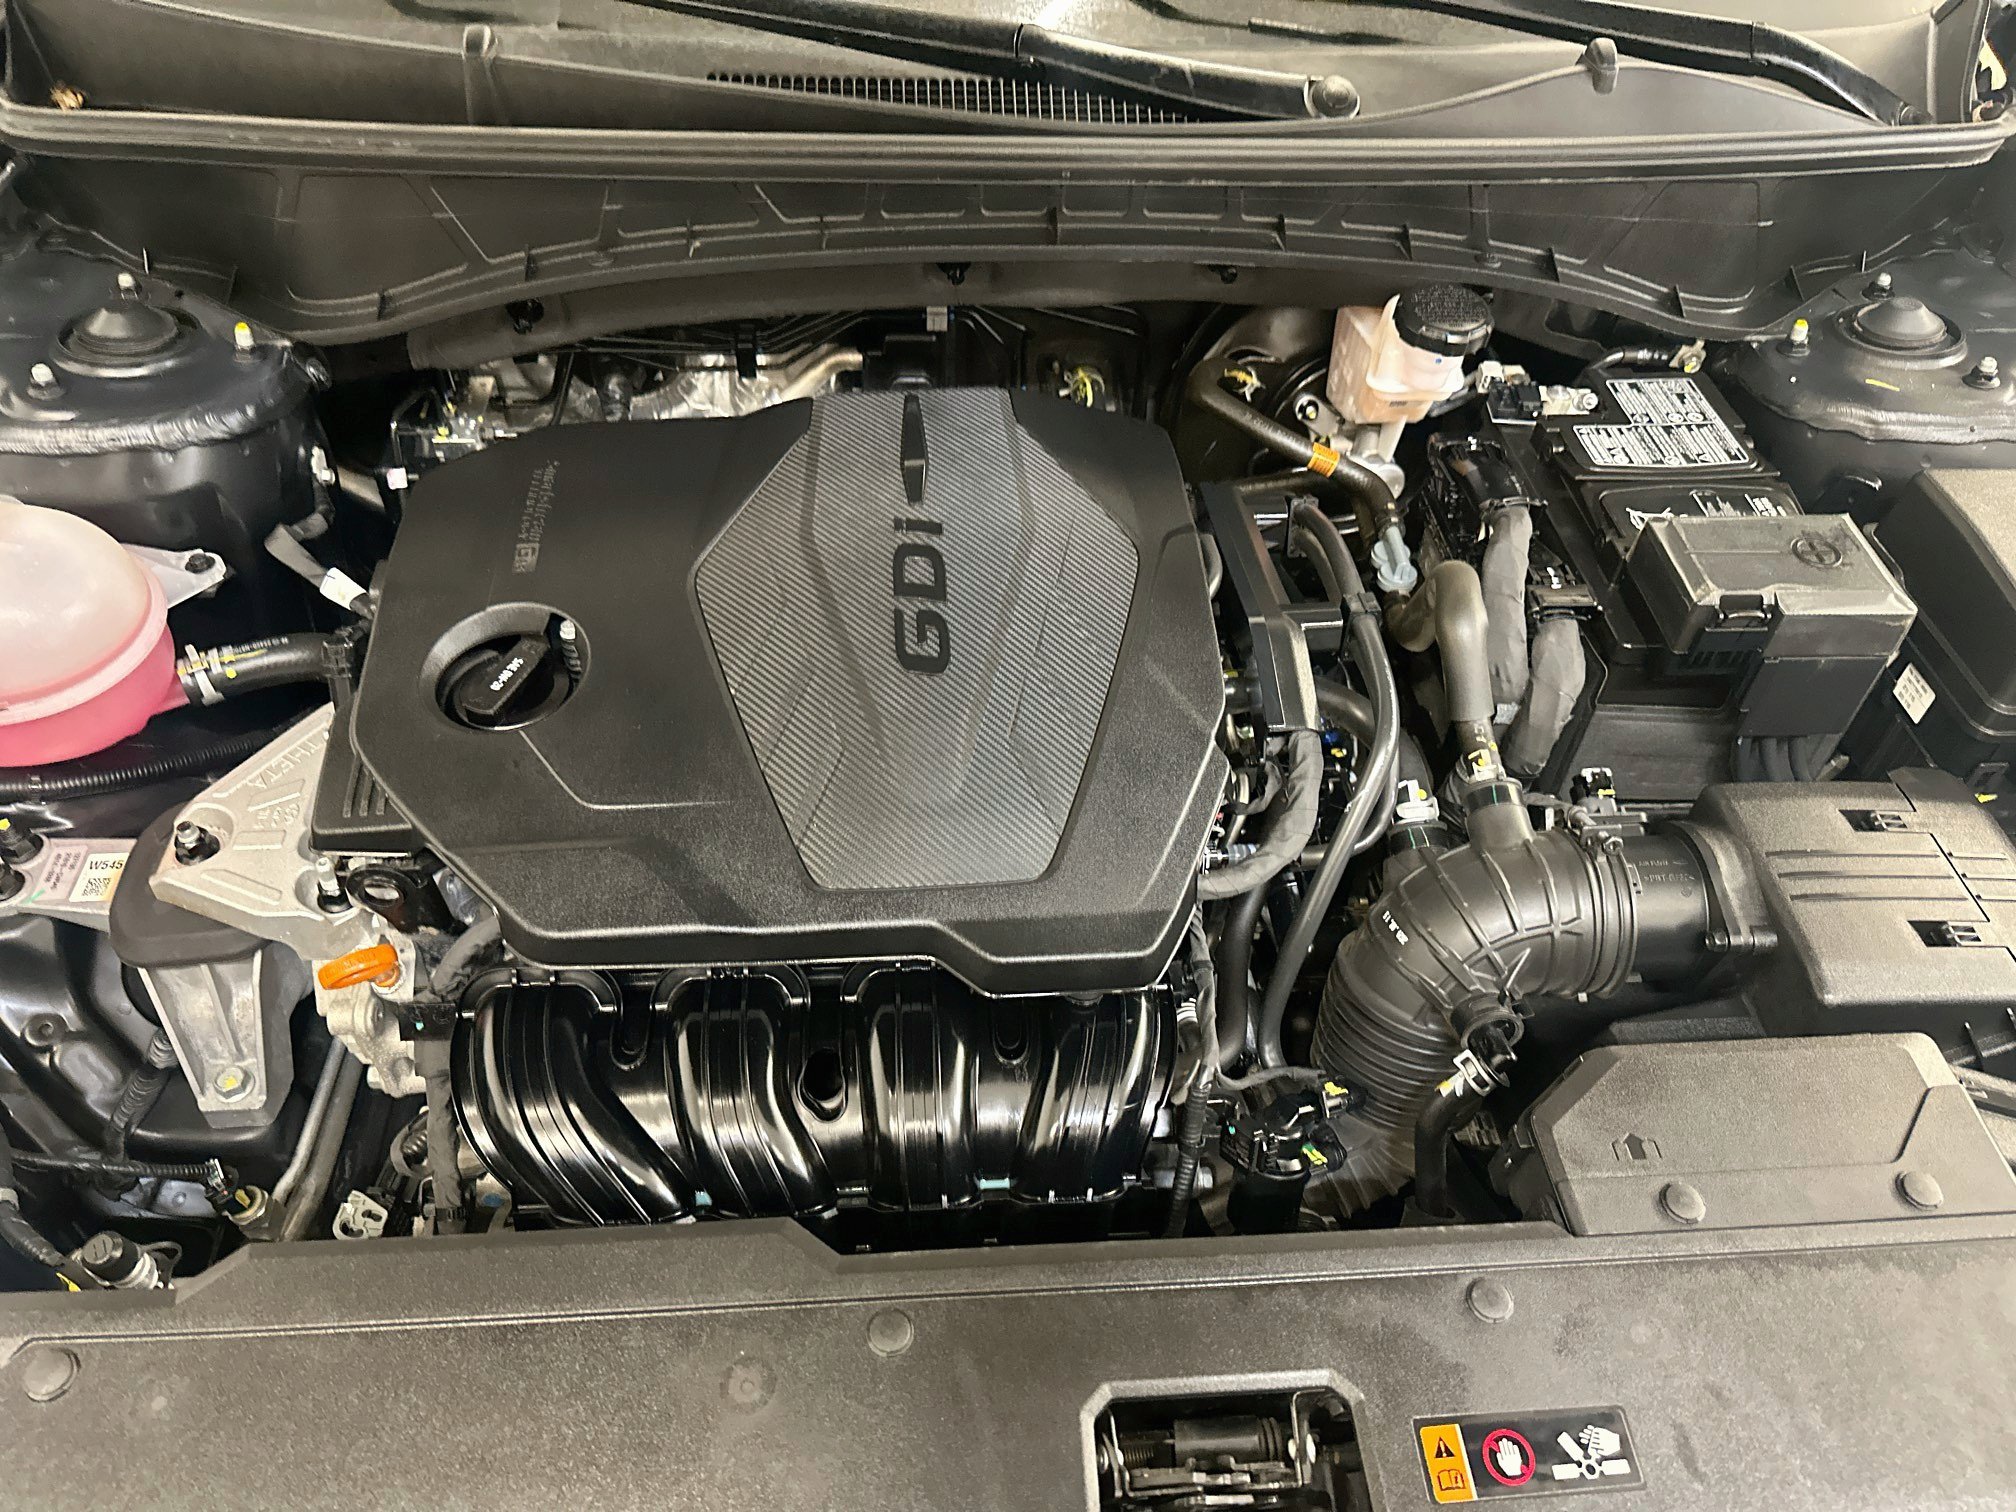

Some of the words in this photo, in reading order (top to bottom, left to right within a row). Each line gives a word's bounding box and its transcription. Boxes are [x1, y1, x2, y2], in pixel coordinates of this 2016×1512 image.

[893, 517, 950, 674] GDi
[246, 737, 320, 789] THETA
[89, 860, 125, 870] W545
